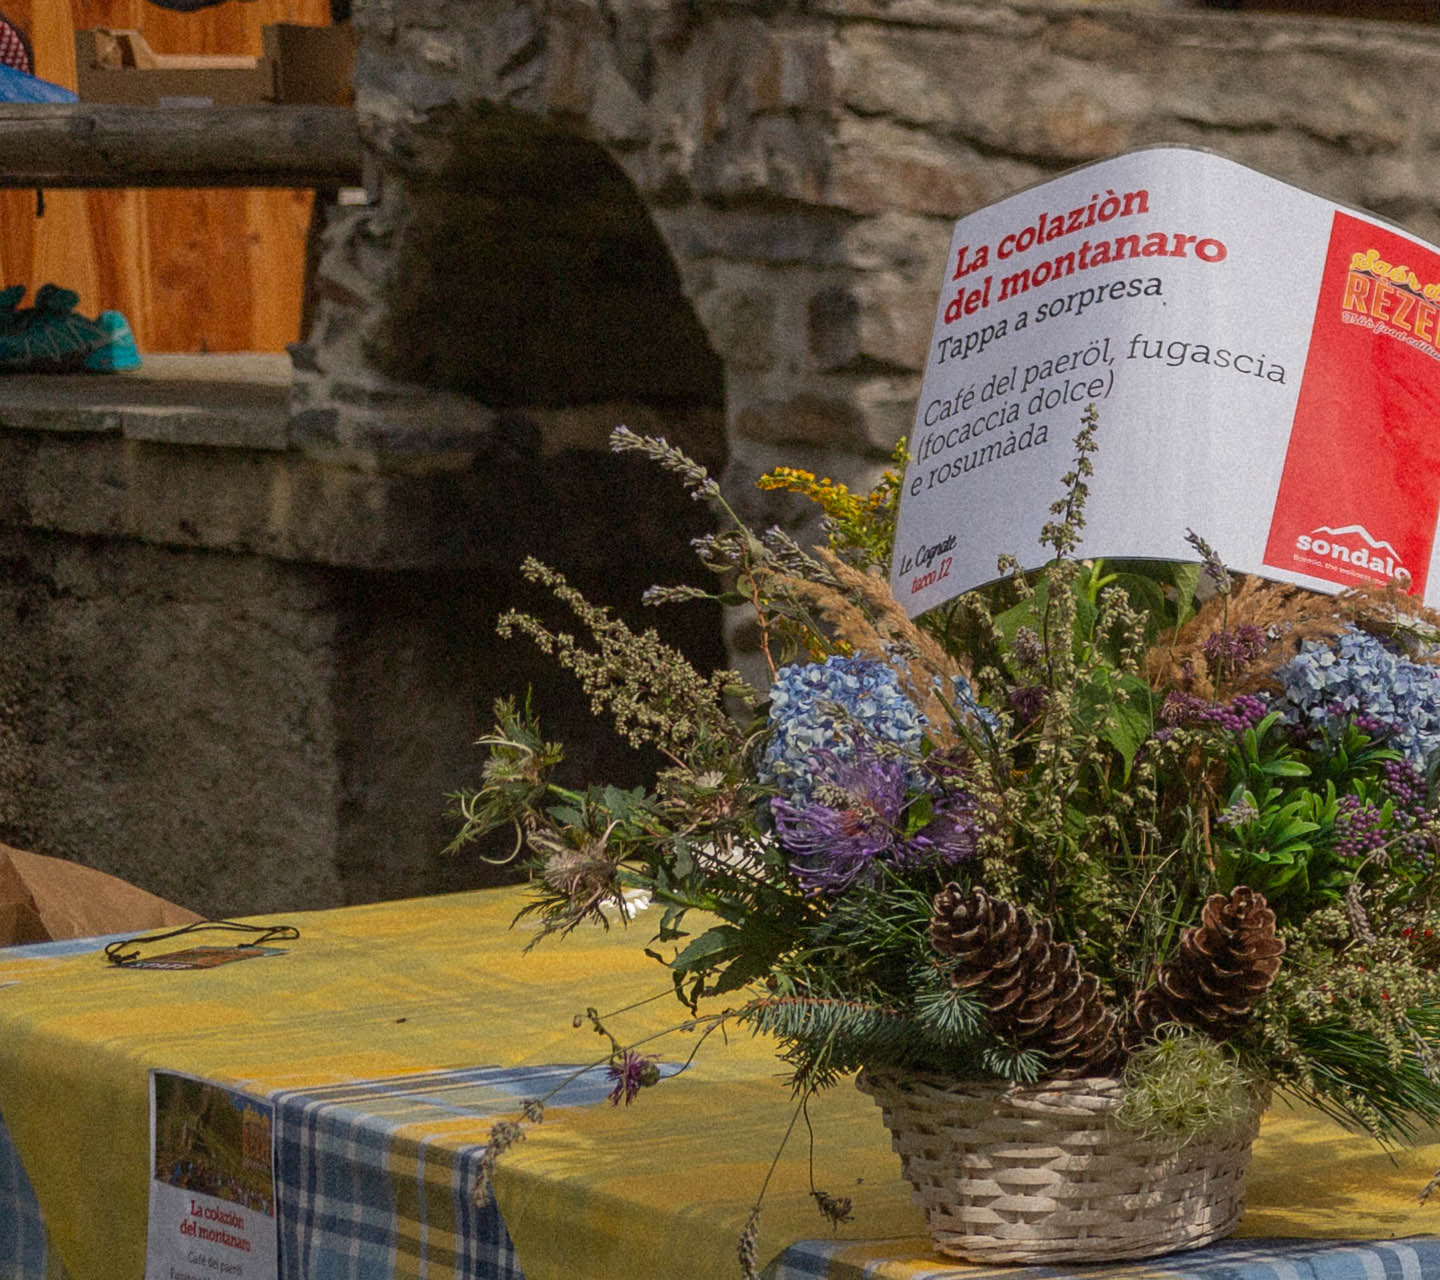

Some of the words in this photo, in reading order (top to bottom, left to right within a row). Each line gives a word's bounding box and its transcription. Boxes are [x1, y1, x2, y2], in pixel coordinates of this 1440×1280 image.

[943, 276, 992, 325] del
[997, 231, 1228, 303] montanaro
[952, 246, 989, 281] La
[997, 189, 1150, 260] colaziòn
[937, 319, 1008, 365] Tappa
[1014, 310, 1029, 331] a
[1034, 276, 1164, 323] sorpresa
[916, 399, 1020, 466] (focaccia
[1027, 369, 1115, 416] dolce)
[923, 387, 975, 428] Café
[980, 367, 1015, 402] del
[1021, 337, 1116, 393] paeröl,
[1127, 333, 1287, 385] fugascia
[909, 477, 923, 498] e
[926, 422, 1049, 490] rosumàda
[1296, 535, 1411, 581] sondalo
[179, 1219, 197, 1237] del
[190, 1199, 203, 1217] La
